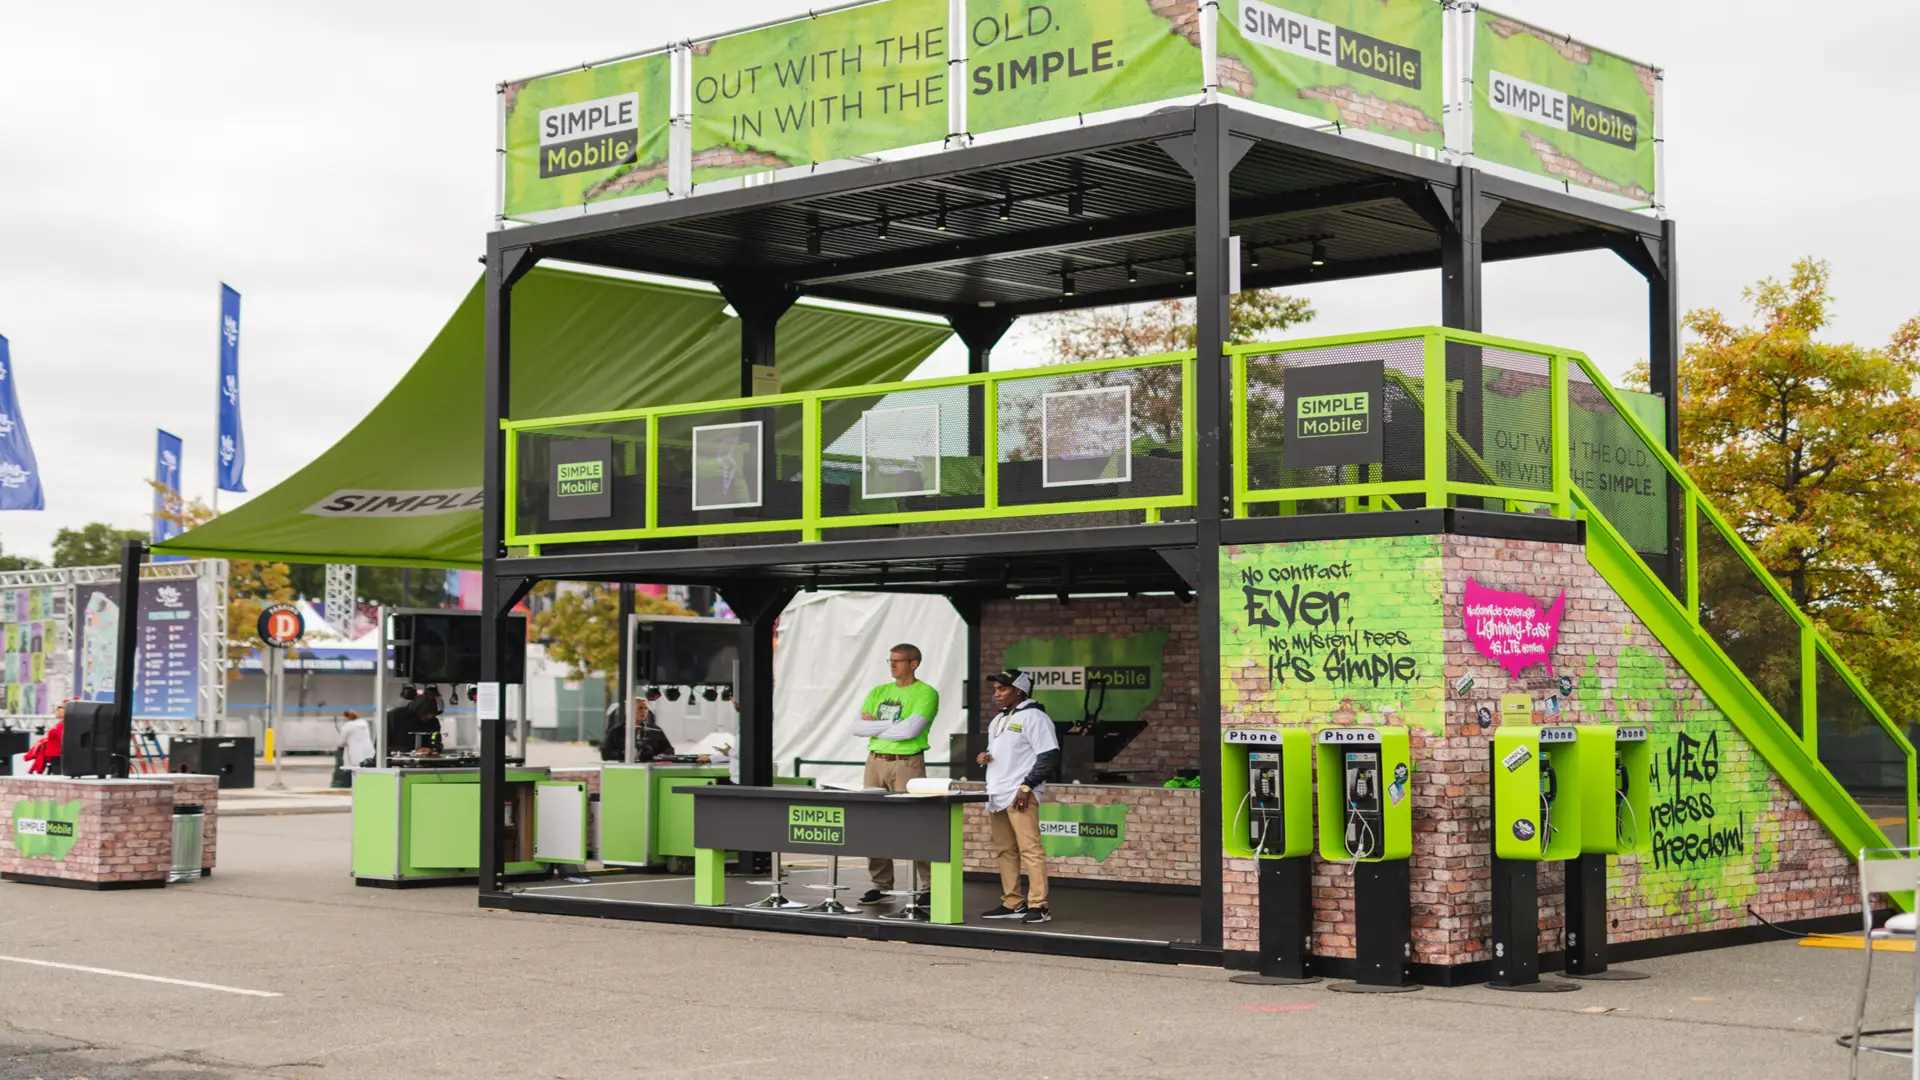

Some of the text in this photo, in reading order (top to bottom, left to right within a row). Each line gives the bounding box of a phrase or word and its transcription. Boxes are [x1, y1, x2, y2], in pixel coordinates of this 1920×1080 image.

[1244, 6, 1417, 81] SIMPLE Mobile
[696, 5, 1061, 103] OUT WITH THE OLD.
[732, 39, 1125, 142] IN WITH THE SIMPLE.
[545, 100, 633, 138] SIMPLE
[1493, 79, 1634, 144] SIMPLE Mobile
[547, 139, 631, 172] Mobile
[1301, 397, 1366, 415] SIMPLE
[1303, 417, 1363, 436] Mobile
[1495, 429, 1530, 452] OUT
[1582, 441, 1610, 463] THE
[1614, 446, 1650, 468] OLD.
[560, 464, 600, 478] SIMPLE
[1495, 460, 1511, 479] IN
[1518, 463, 1548, 484] WIT
[1599, 473, 1656, 496] SIMPLE.
[561, 480, 599, 494] Mobile
[1242, 566, 1264, 586] No
[1242, 584, 1355, 629] Ever.
[275, 615, 295, 637] D
[1268, 635, 1288, 653] No
[1503, 639, 1522, 655] LTE
[1268, 649, 1315, 685] It's
[1229, 731, 1277, 742] Phone
[1325, 731, 1375, 741] Phone
[1541, 730, 1573, 740] Phone
[1616, 729, 1644, 738] Phone
[1504, 746, 1526, 766] SIMPLE
[1509, 754, 1530, 771] Mobile
[1667, 731, 1718, 797] YES
[792, 810, 841, 823] SIMPLE
[1650, 792, 1715, 831] reless
[19, 820, 72, 835] SIMPLE Mobile
[793, 827, 839, 842] Mobile
[1040, 824, 1116, 836] SIMPLE Mobile
[1653, 810, 1744, 870] freedom!
